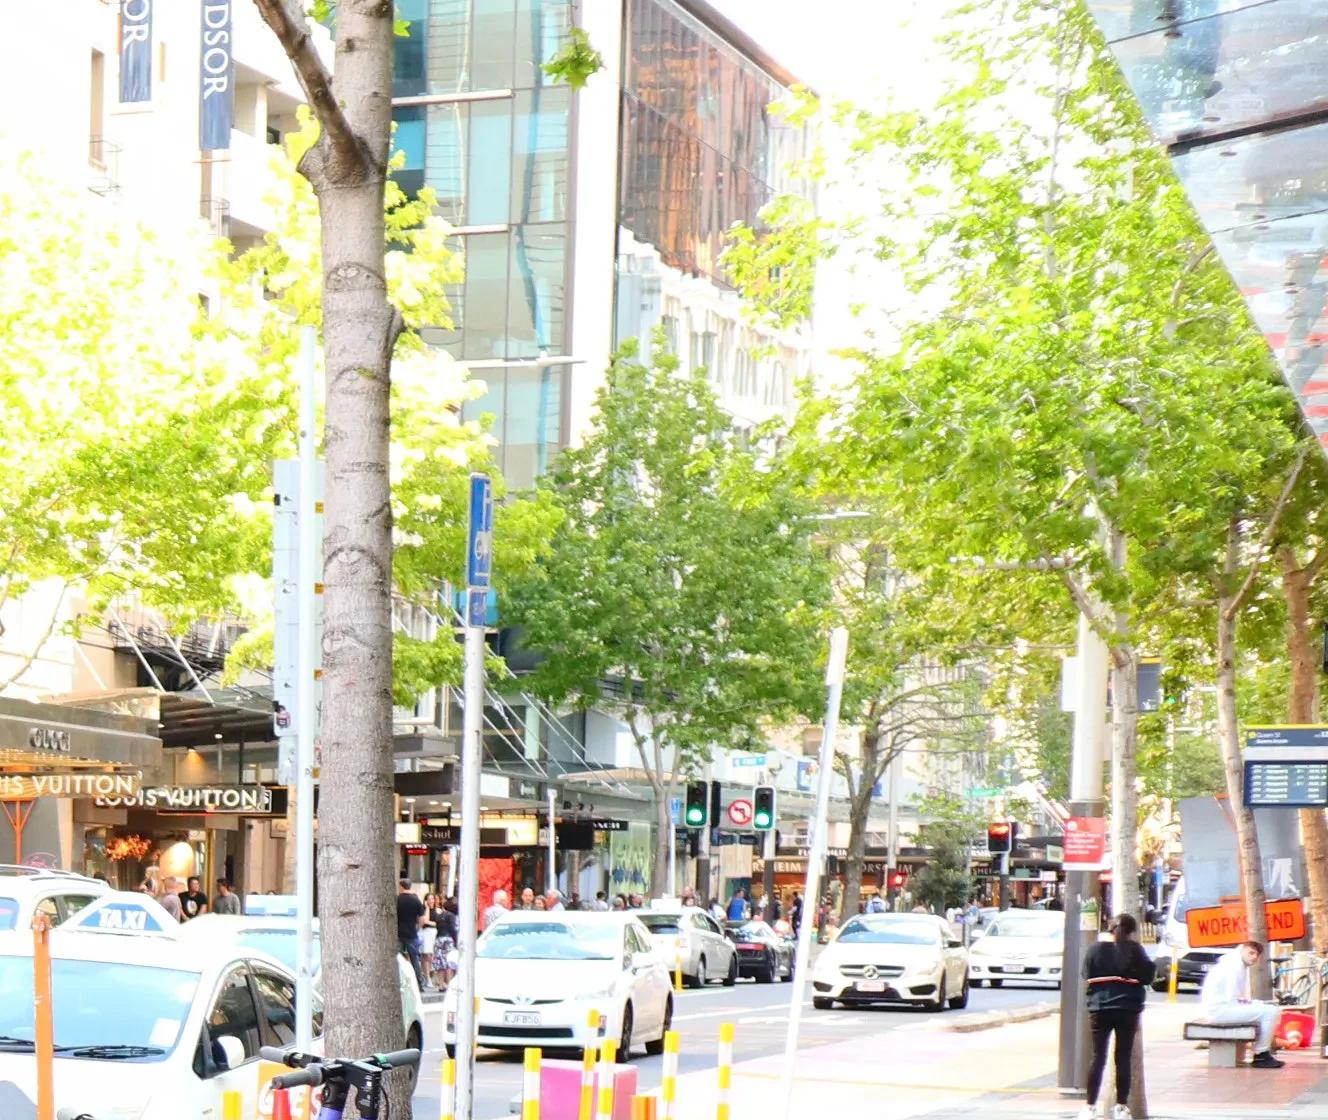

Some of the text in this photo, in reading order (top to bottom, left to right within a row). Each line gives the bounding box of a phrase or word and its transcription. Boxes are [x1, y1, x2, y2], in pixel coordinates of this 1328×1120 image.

[34, 774, 133, 795] VUITTON
[166, 788, 257, 808] VUITTON
[98, 908, 147, 930] TAXI
[1197, 911, 1294, 937] WORKS END
